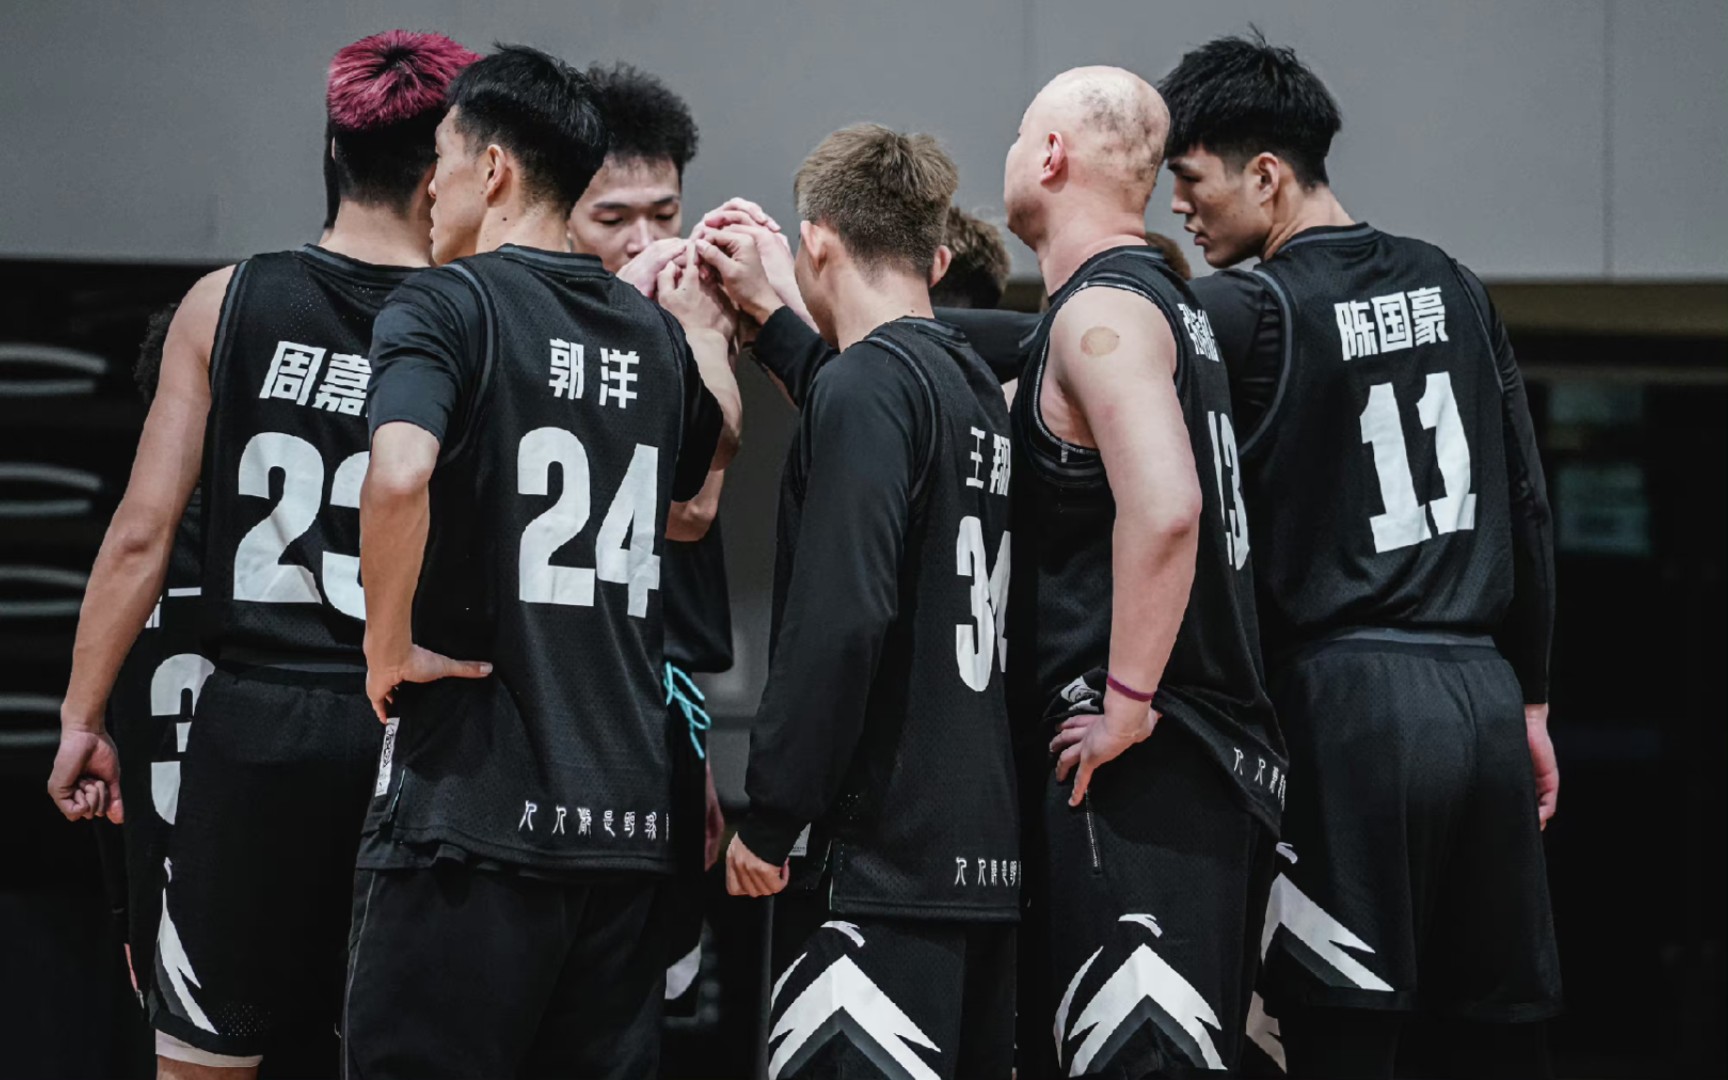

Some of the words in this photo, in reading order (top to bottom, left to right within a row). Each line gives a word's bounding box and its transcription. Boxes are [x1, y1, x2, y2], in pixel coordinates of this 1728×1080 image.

[259, 340, 372, 418] 周嘉
[549, 338, 640, 409] 郭洋
[1334, 286, 1449, 361] 陈国豪
[517, 426, 661, 619] 24
[1207, 411, 1250, 571] 13
[1359, 371, 1477, 554] 11
[956, 515, 1012, 692] 34
